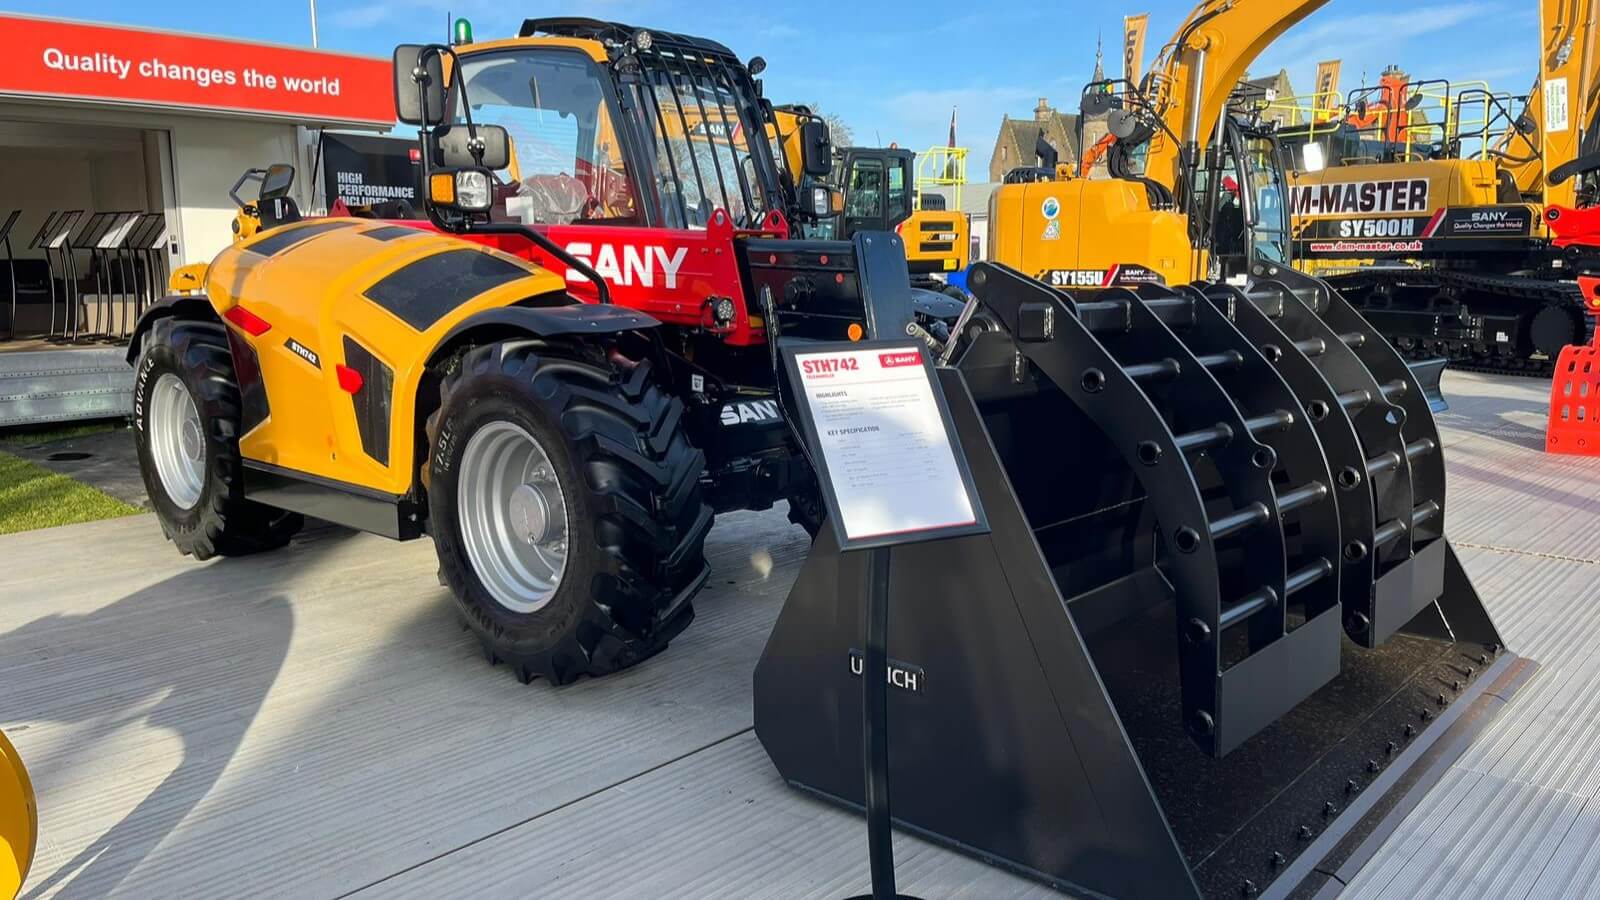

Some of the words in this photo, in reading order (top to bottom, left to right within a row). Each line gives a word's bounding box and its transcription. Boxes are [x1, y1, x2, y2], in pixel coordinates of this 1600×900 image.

[43, 48, 131, 80] Quality
[139, 58, 236, 87] changes
[243, 69, 277, 89] the
[283, 76, 341, 96] world
[337, 172, 362, 184] HIGH
[338, 184, 414, 199] PERFORMANCE
[1471, 212, 1508, 221] SANY
[1340, 218, 1414, 237] SY500H
[1454, 222, 1472, 230] Quality
[1473, 222, 1495, 230] Changes
[565, 242, 689, 289] SANY
[1051, 270, 1103, 285] SY155U
[802, 357, 859, 373] STH742
[135, 358, 155, 432] ADVANCE
[720, 400, 778, 426] SAN
[851, 656, 917, 691] UICH
